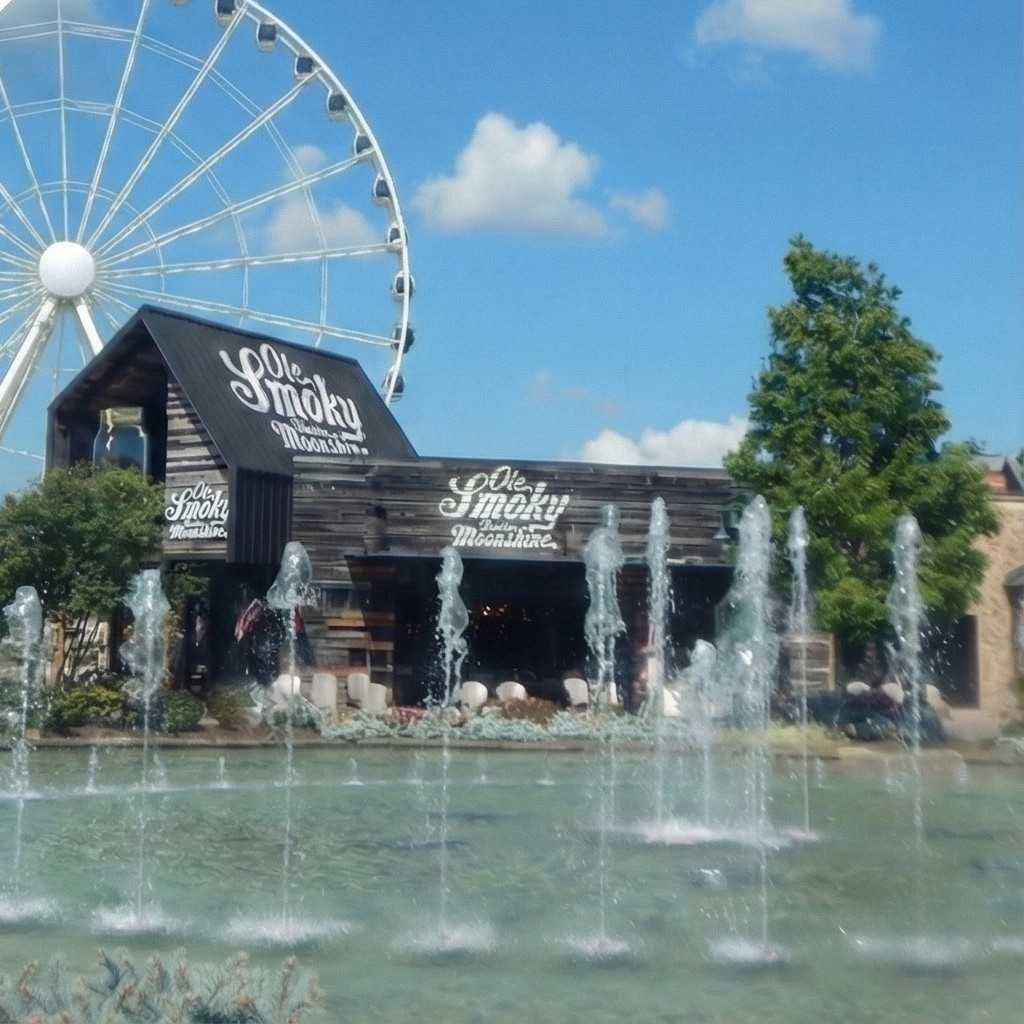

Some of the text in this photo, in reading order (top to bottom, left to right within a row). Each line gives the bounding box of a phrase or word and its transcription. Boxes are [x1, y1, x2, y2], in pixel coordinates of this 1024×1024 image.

[260, 343, 316, 391] Ole
[219, 347, 365, 442] Smoky
[489, 466, 533, 493] Ole
[165, 488, 229, 526] Smoky
[439, 473, 570, 532] Smoky
[451, 524, 558, 549] Moonshine
